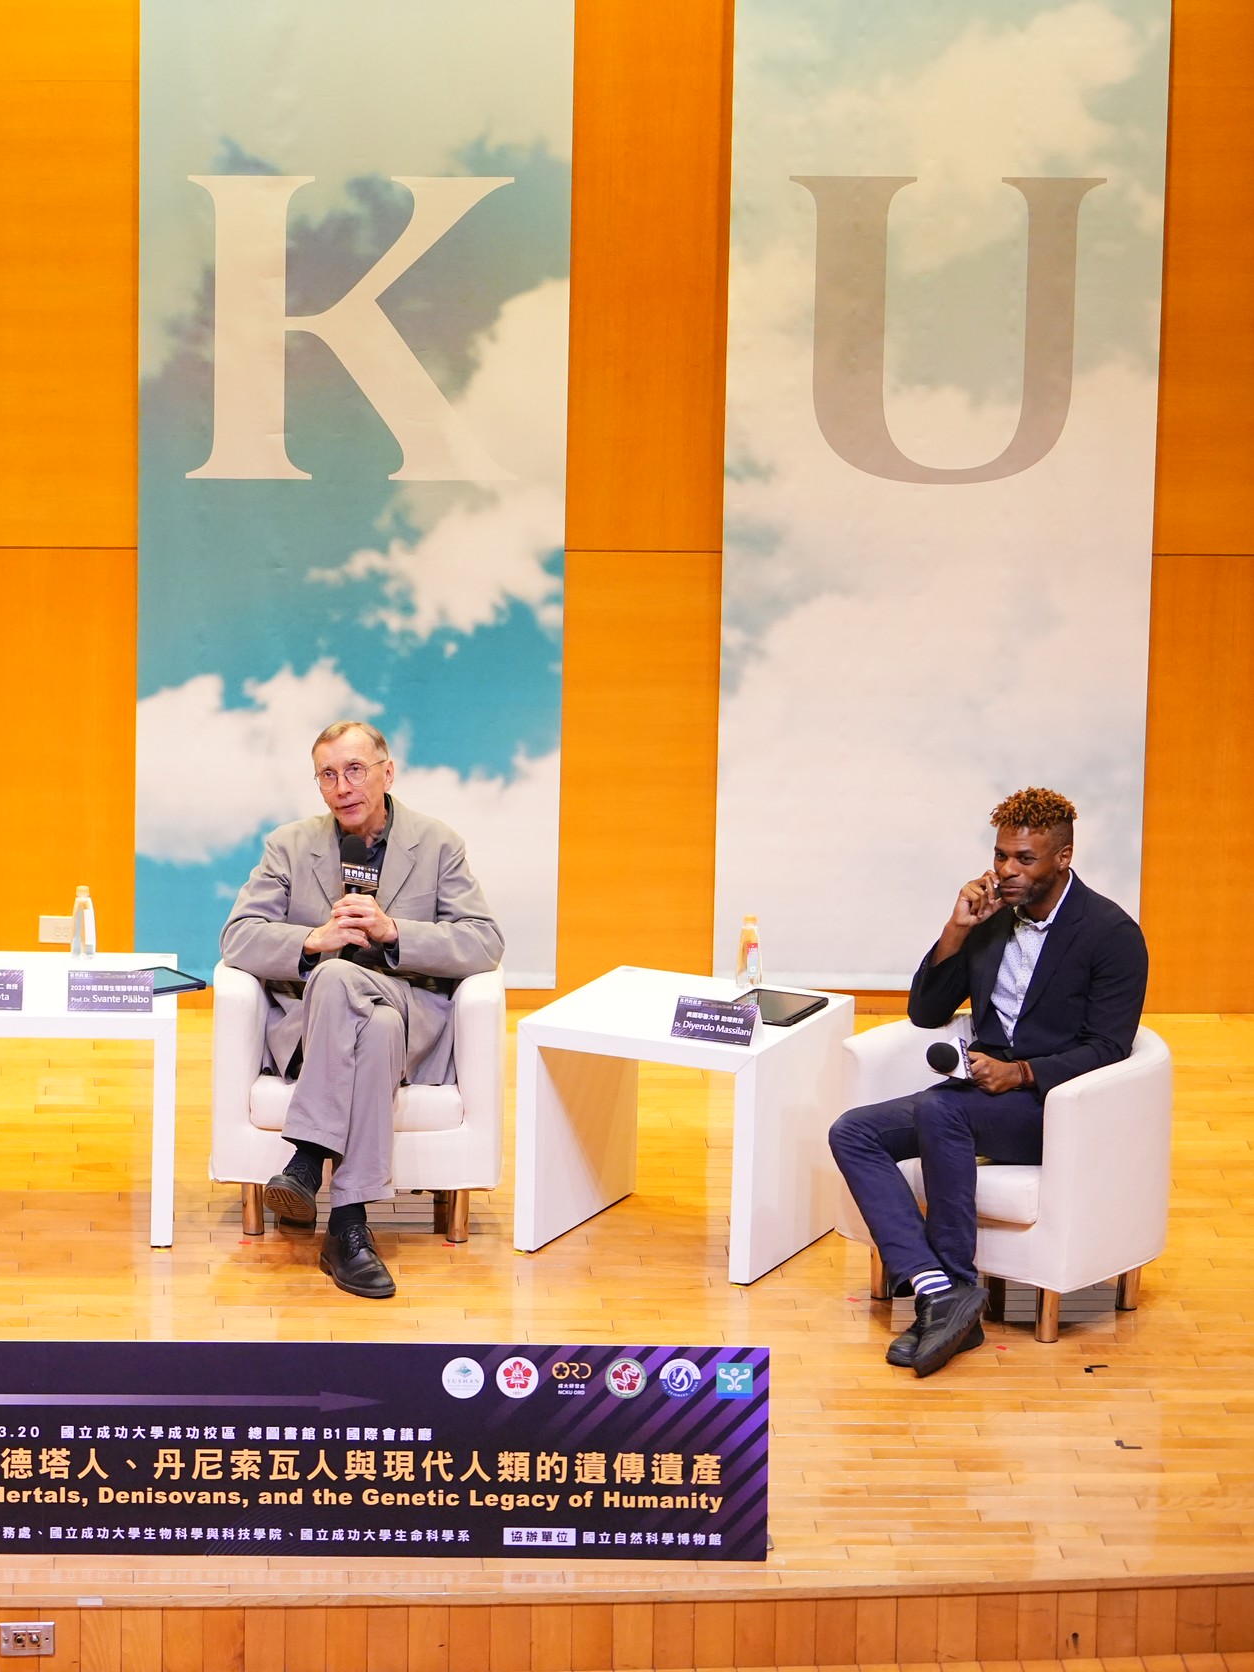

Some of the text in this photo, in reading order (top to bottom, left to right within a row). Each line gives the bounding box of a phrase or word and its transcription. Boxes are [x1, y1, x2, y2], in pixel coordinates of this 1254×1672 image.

[185, 175, 519, 481] K
[789, 175, 1107, 485] U
[92, 994, 121, 1003] Svante
[122, 994, 150, 1004] Pääbo
[683, 1021, 715, 1032] Diyendo
[716, 1026, 751, 1037] Massilani
[60, 1425, 236, 1440] 國立成功大學成功校區
[247, 1426, 316, 1441] 總圖書館
[323, 1428, 341, 1440] B1
[345, 1427, 433, 1441] 國際會議廳
[98, 1487, 249, 1508] Denisovans,
[258, 1488, 303, 1505] and
[312, 1488, 353, 1505] the
[362, 1488, 460, 1507] Genetic
[469, 1489, 560, 1511] Legacy
[568, 1491, 594, 1508] of
[603, 1491, 723, 1513] Humanity
[511, 1531, 722, 1546] 協辦單位 國立自然科學博物館
